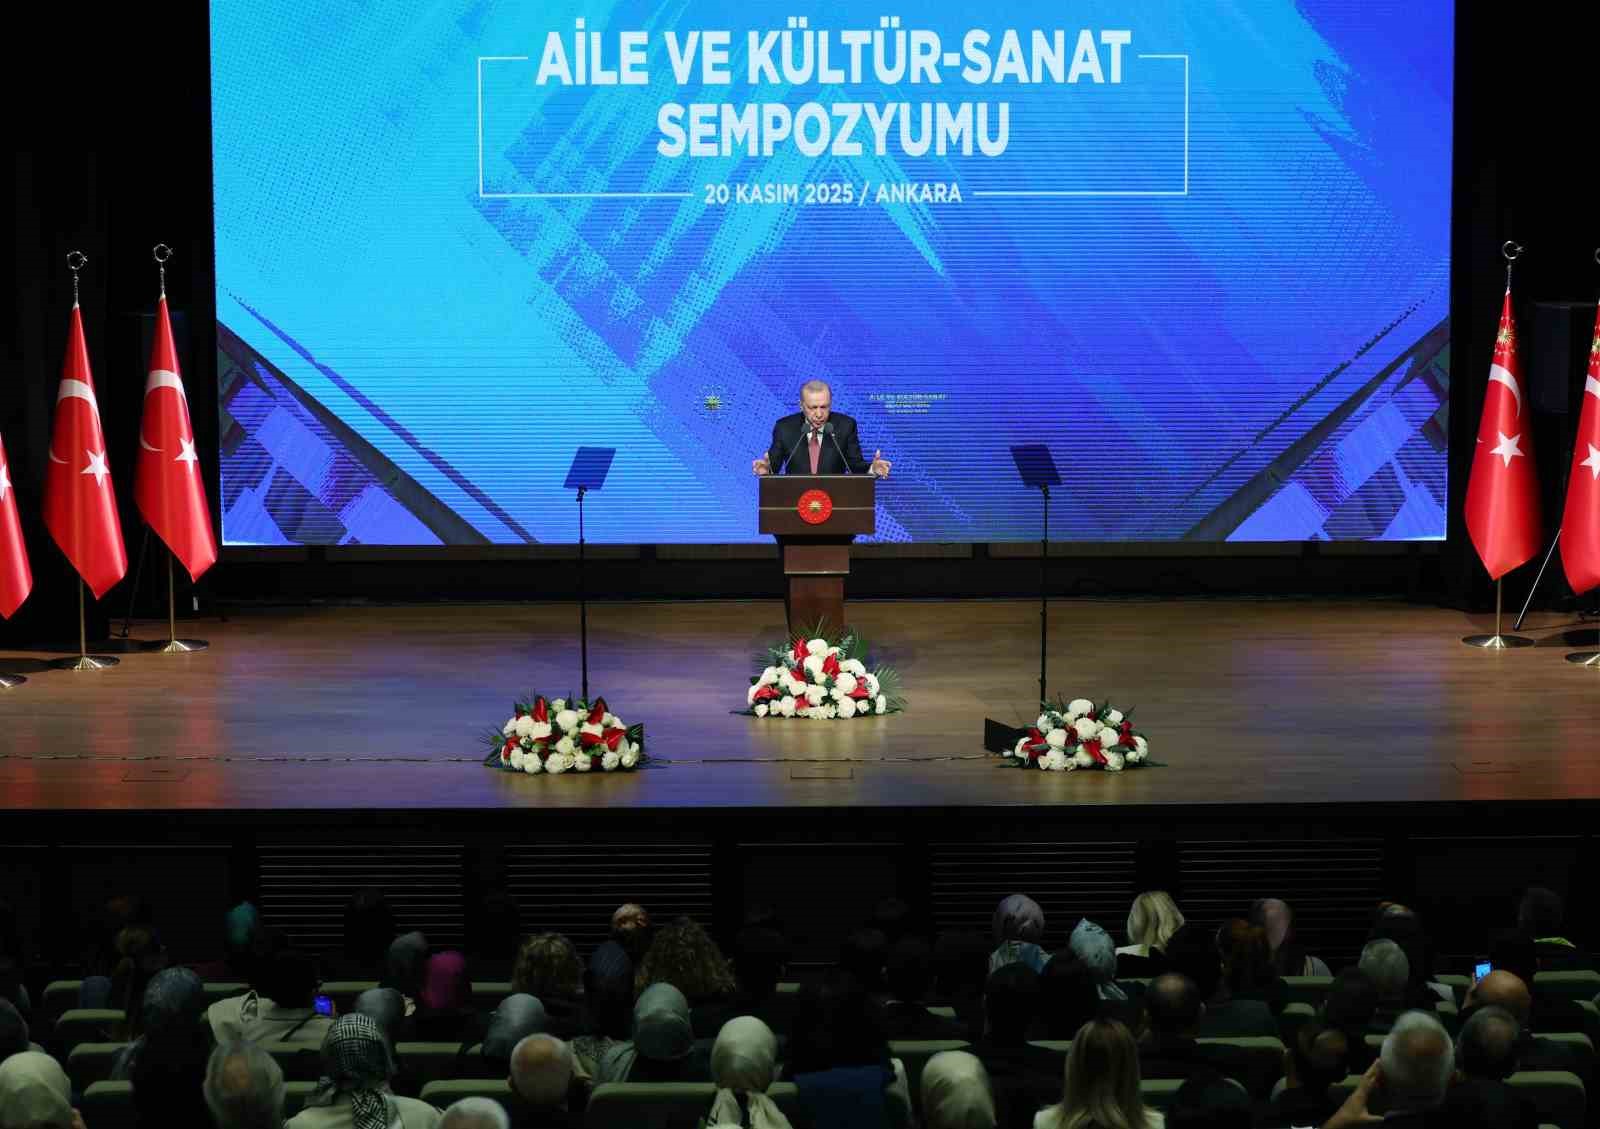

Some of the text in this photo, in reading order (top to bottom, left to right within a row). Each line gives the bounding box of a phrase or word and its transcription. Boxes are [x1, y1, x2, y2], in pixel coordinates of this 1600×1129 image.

[535, 16, 1132, 85] AİLE VE KÜLTÜR-SANAT
[657, 103, 1009, 157] SEMPOZYUMU
[705, 183, 963, 207] 20 KASIM 2025 / ANKARA
